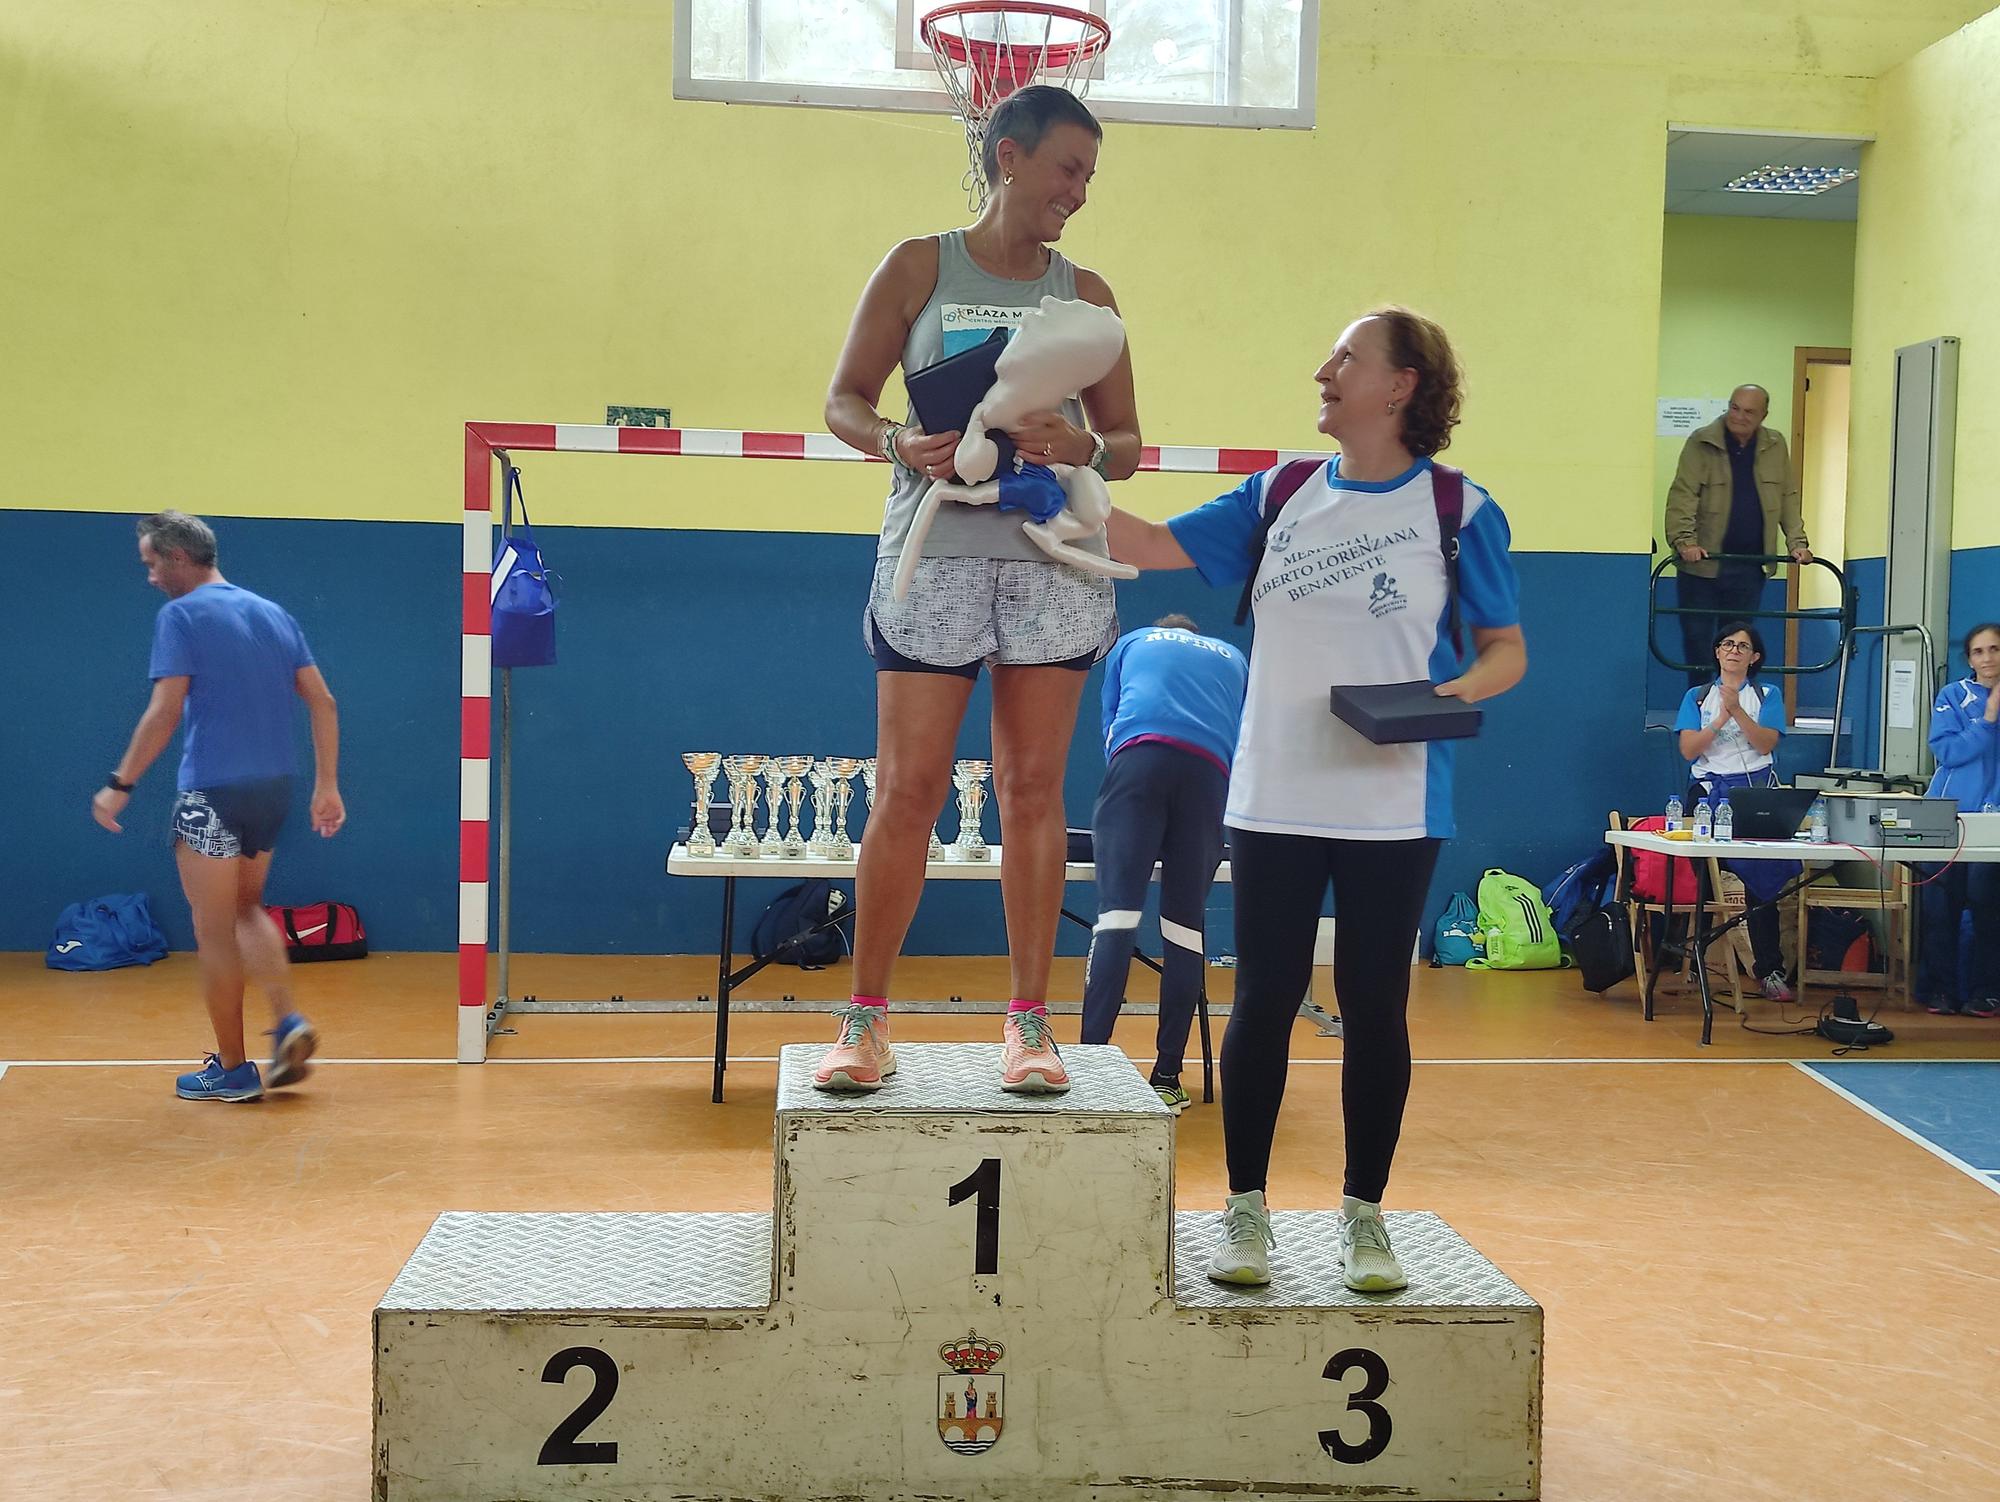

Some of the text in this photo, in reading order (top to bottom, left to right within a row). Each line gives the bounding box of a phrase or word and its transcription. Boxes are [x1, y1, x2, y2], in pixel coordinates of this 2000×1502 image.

[966, 308, 1008, 318] PLAZA
[1317, 527, 1420, 571] LORENZANA
[1287, 554, 1386, 602] BENAVENTE
[1145, 632, 1232, 659] RUFINO
[949, 1159, 1001, 1274] 1
[537, 1347, 618, 1465] 2
[1318, 1348, 1392, 1465] 3
